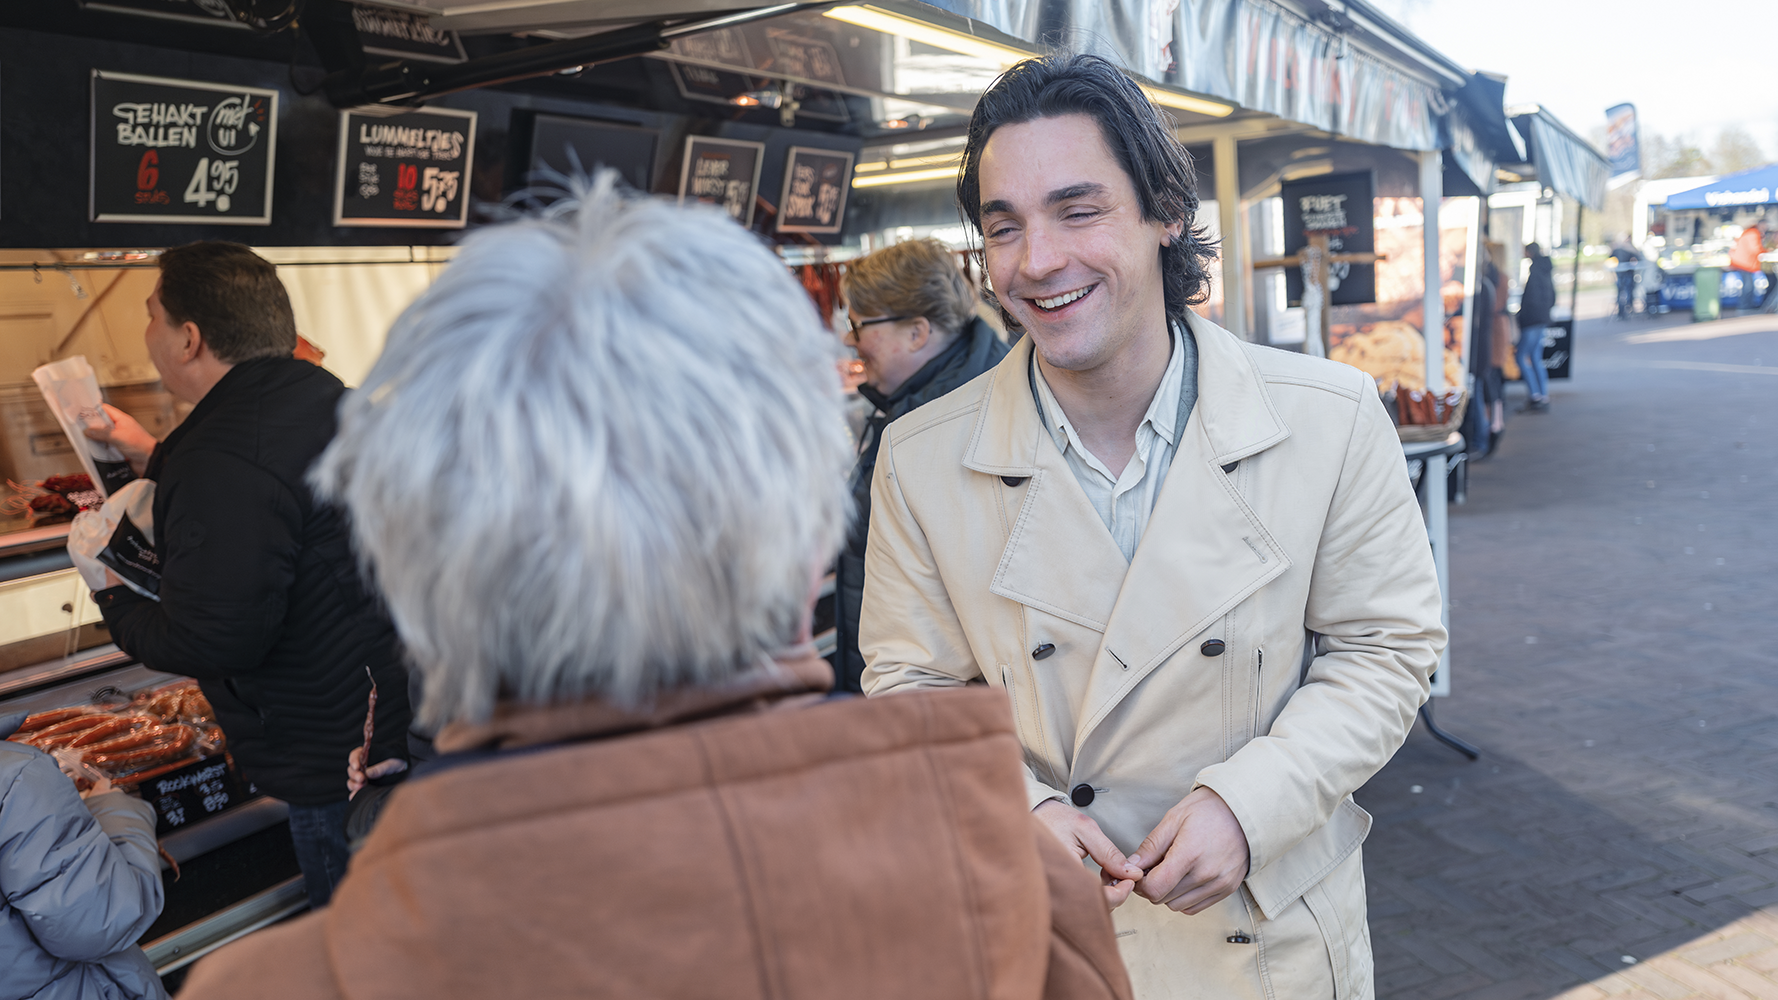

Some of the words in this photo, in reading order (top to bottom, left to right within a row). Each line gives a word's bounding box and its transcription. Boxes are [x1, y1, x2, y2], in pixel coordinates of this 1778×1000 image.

[112, 102, 208, 126] GEHAKT
[117, 122, 198, 149] BALLEN
[217, 127, 237, 148] UI
[136, 149, 160, 191] 6
[397, 162, 418, 190] 10
